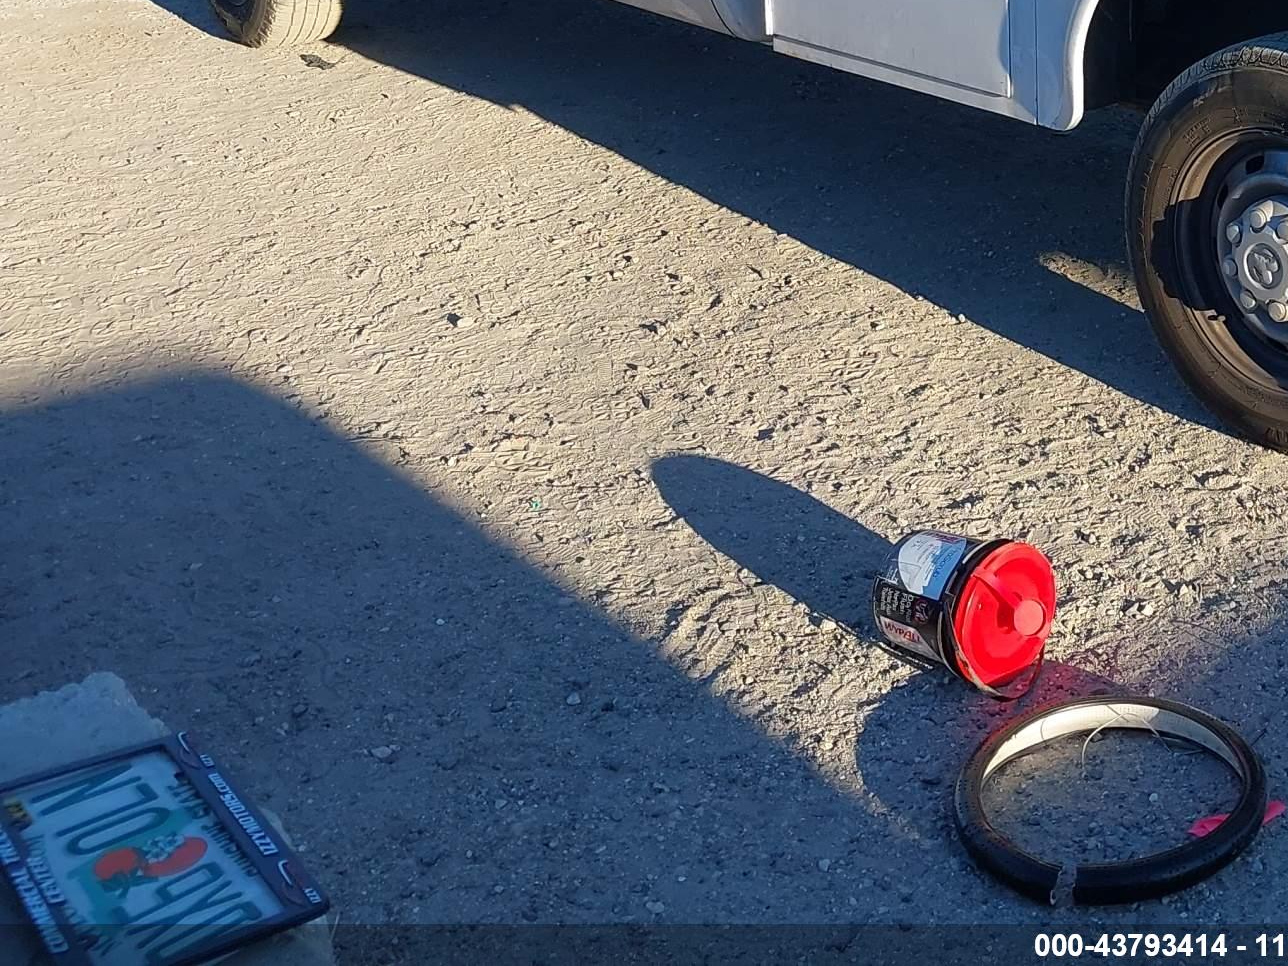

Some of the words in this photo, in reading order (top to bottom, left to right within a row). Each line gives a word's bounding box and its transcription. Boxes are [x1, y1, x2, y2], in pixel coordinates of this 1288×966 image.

[208, 772, 279, 856] IZZYMOTORS.com
[11, 867, 69, 954] COMMERCIAL
[27, 857, 65, 904] CENTER
[303, 887, 322, 904] IZZY
